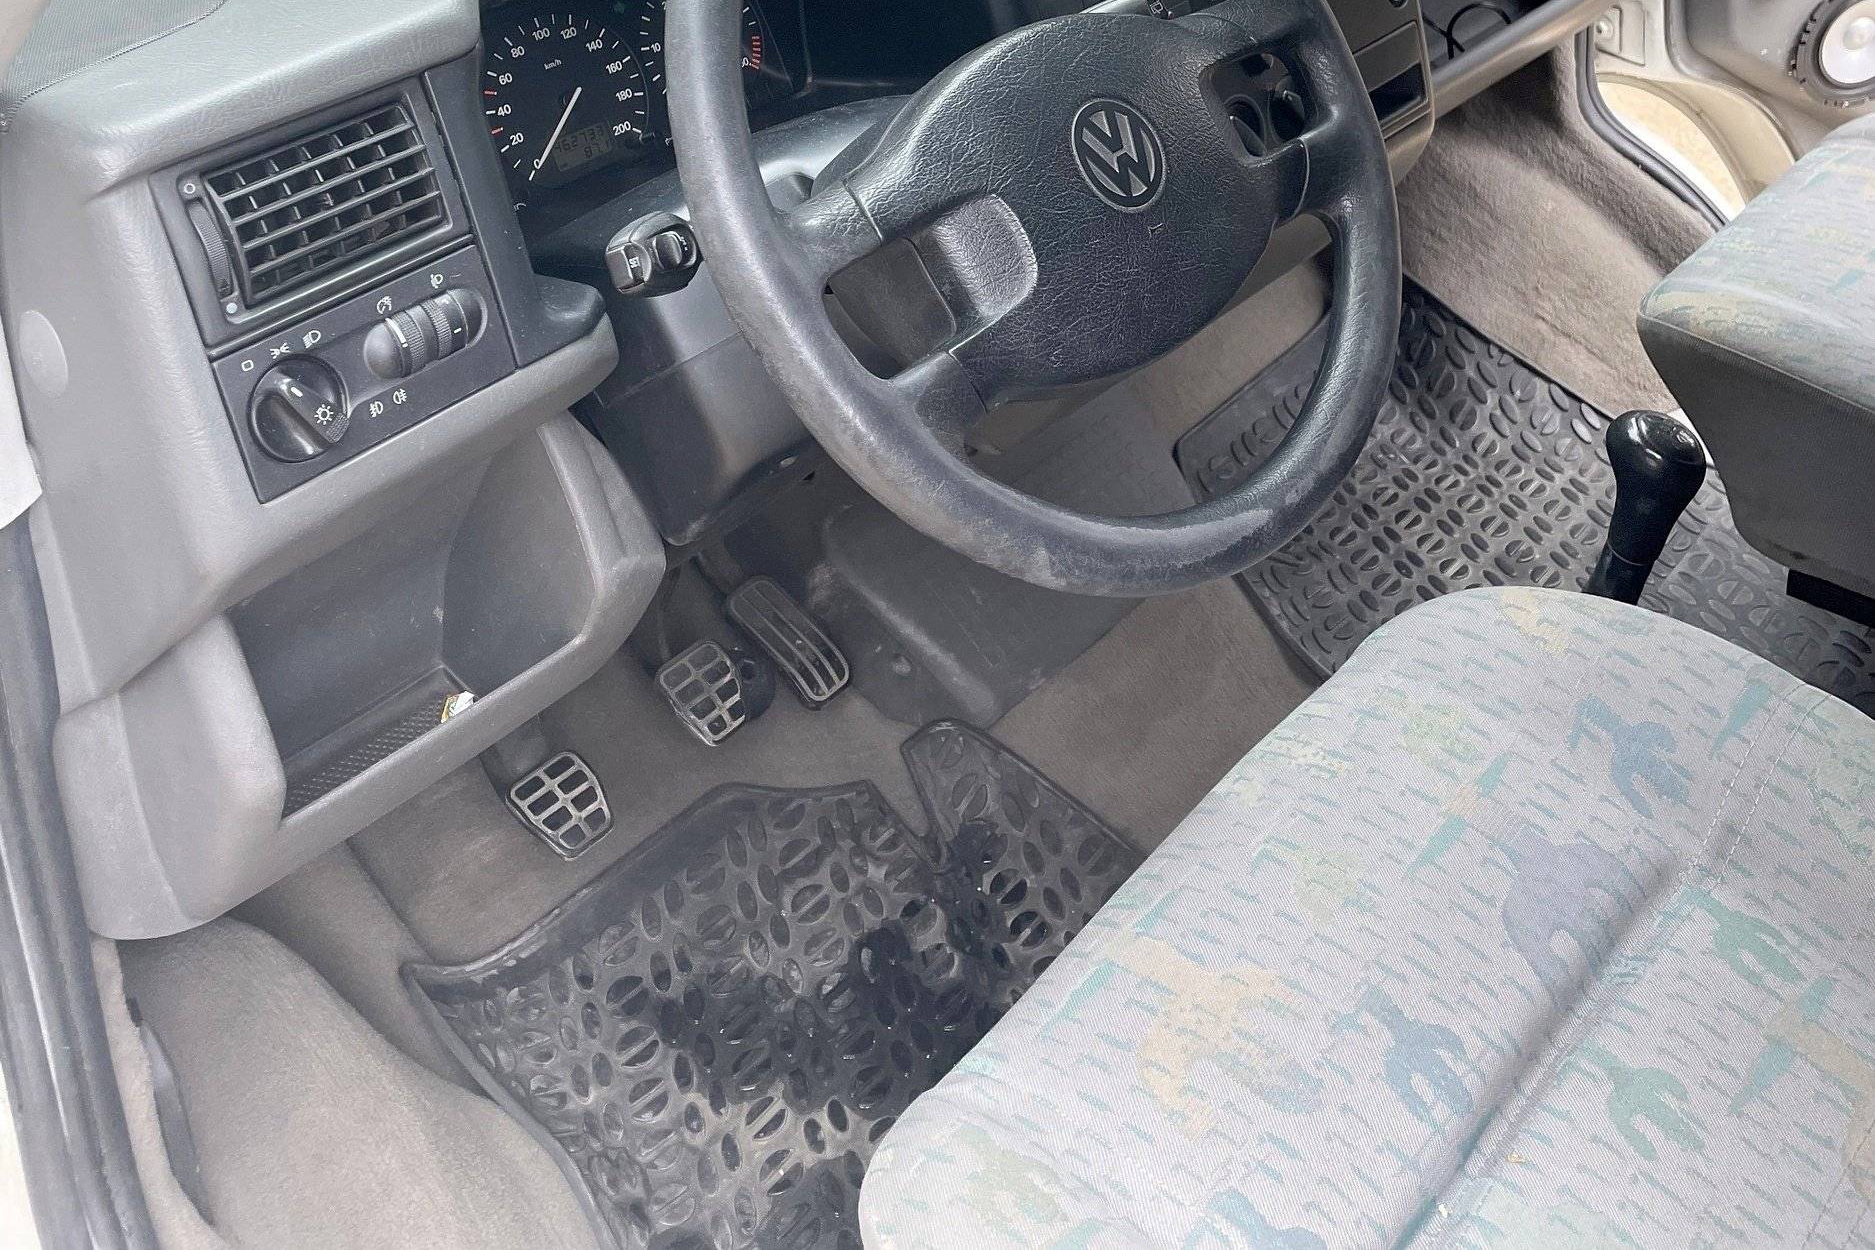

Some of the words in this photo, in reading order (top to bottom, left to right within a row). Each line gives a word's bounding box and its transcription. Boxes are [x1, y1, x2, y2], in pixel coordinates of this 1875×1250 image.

[532, 28, 550, 41] 100
[560, 27, 577, 40] 120
[511, 46, 525, 58] 80
[586, 39, 603, 52] 140
[651, 43, 661, 53] 10
[544, 59, 562, 70] km/h
[606, 61, 623, 74] 160
[499, 73, 513, 85] 60
[616, 89, 633, 102] 180
[498, 104, 511, 116] 40
[613, 121, 631, 136] 200
[510, 133, 524, 146] 20
[533, 158, 540, 169] 0
